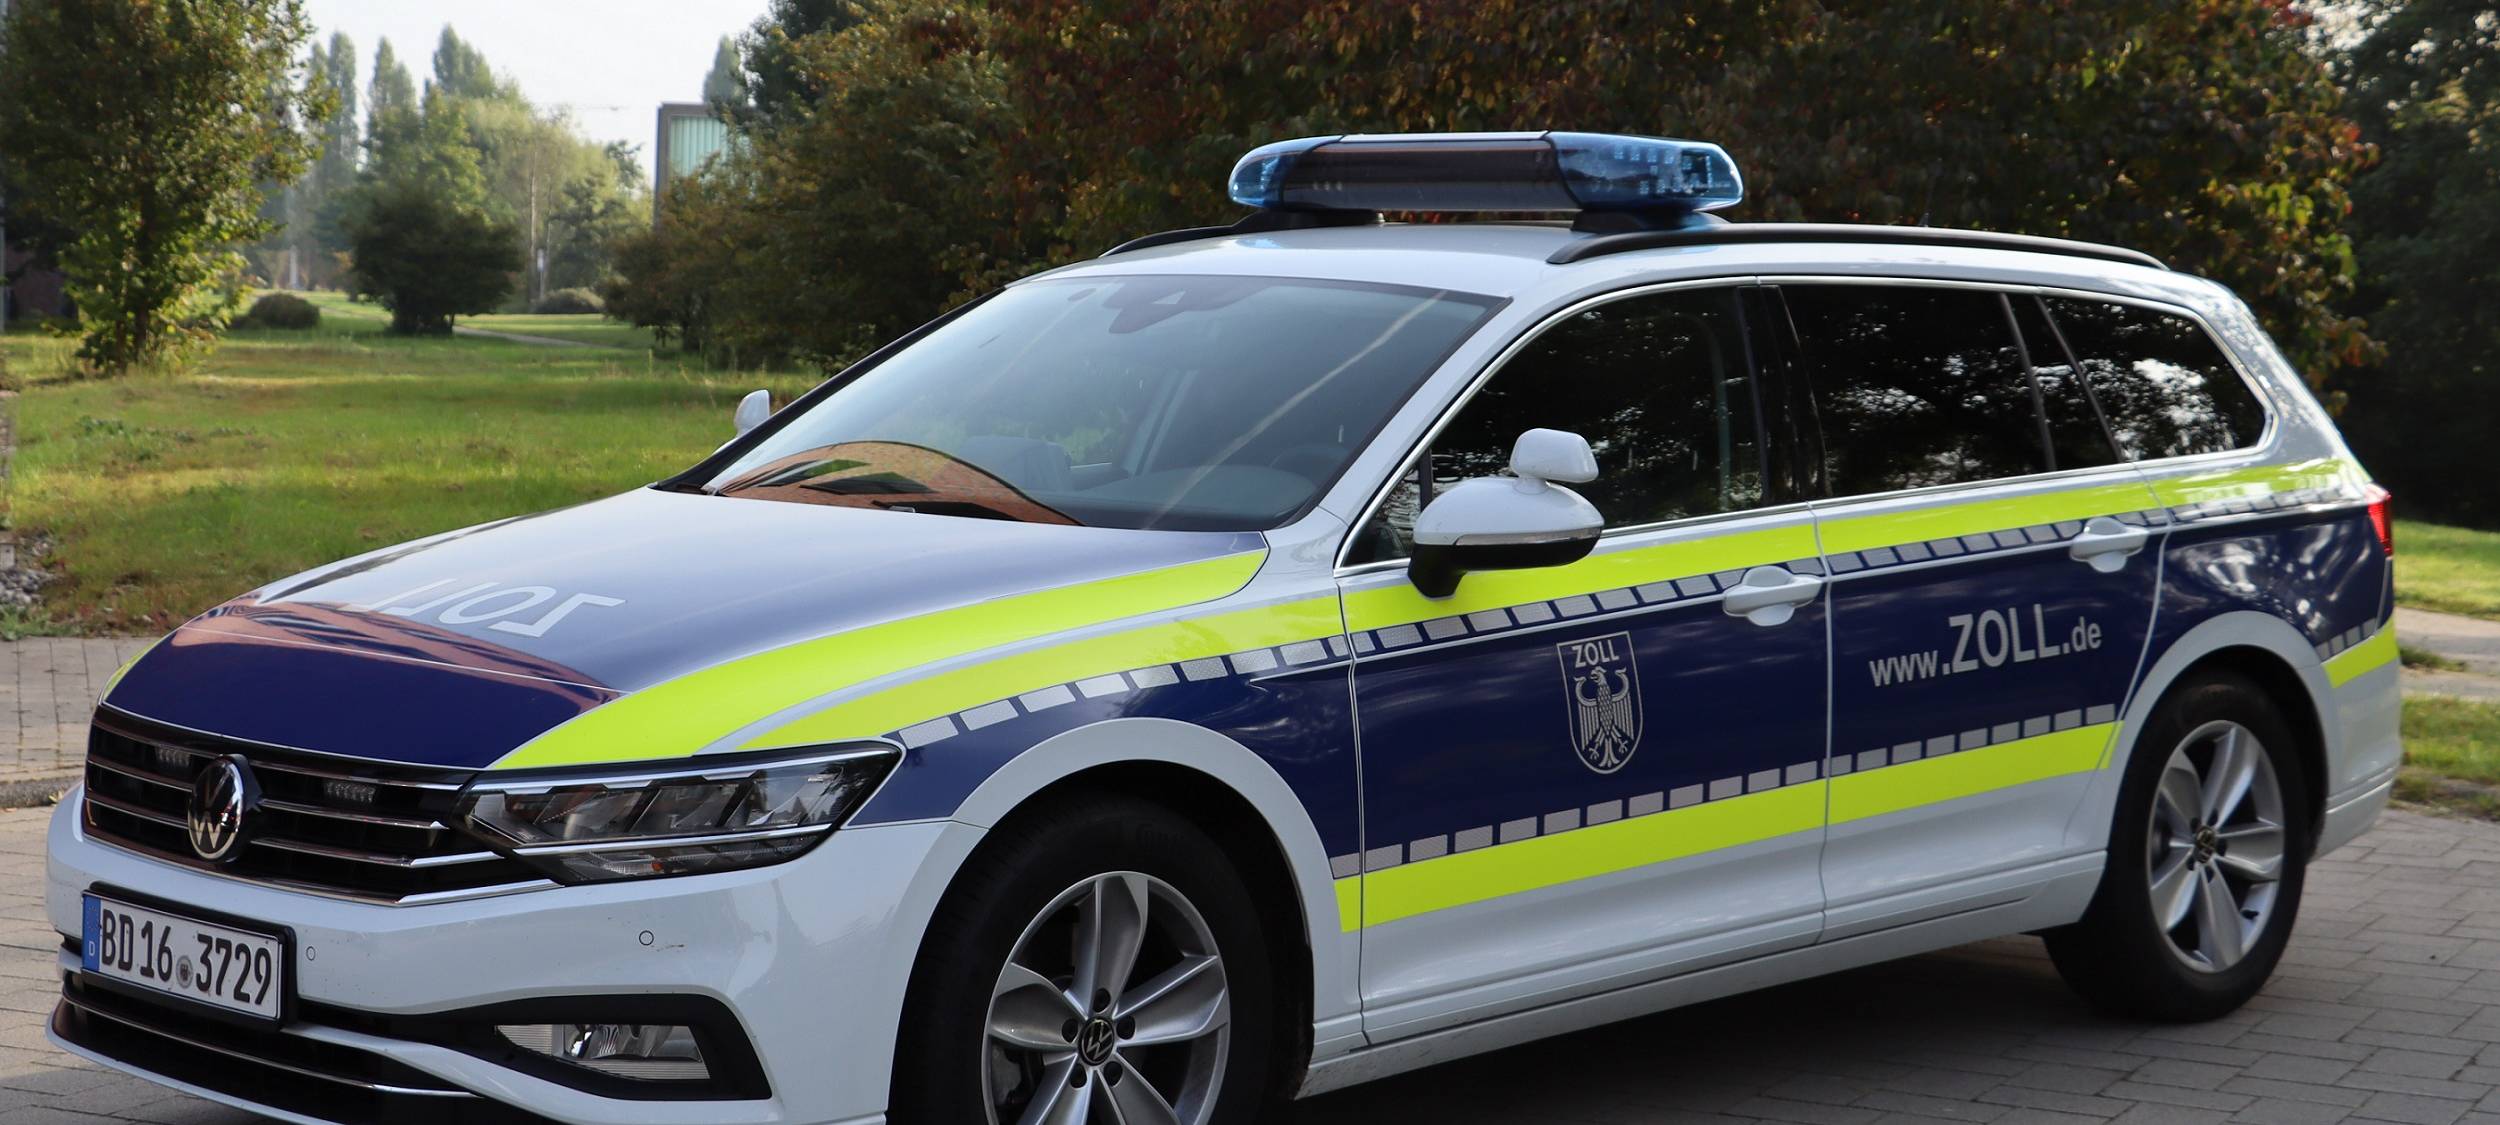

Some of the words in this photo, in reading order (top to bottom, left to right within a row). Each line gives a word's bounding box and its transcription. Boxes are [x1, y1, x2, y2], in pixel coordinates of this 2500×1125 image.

[1571, 639, 1620, 669] ZOLL
[1868, 603, 2102, 687] www.ZOLL.de
[88, 940, 96, 957] D
[196, 933, 271, 1005] 3729
